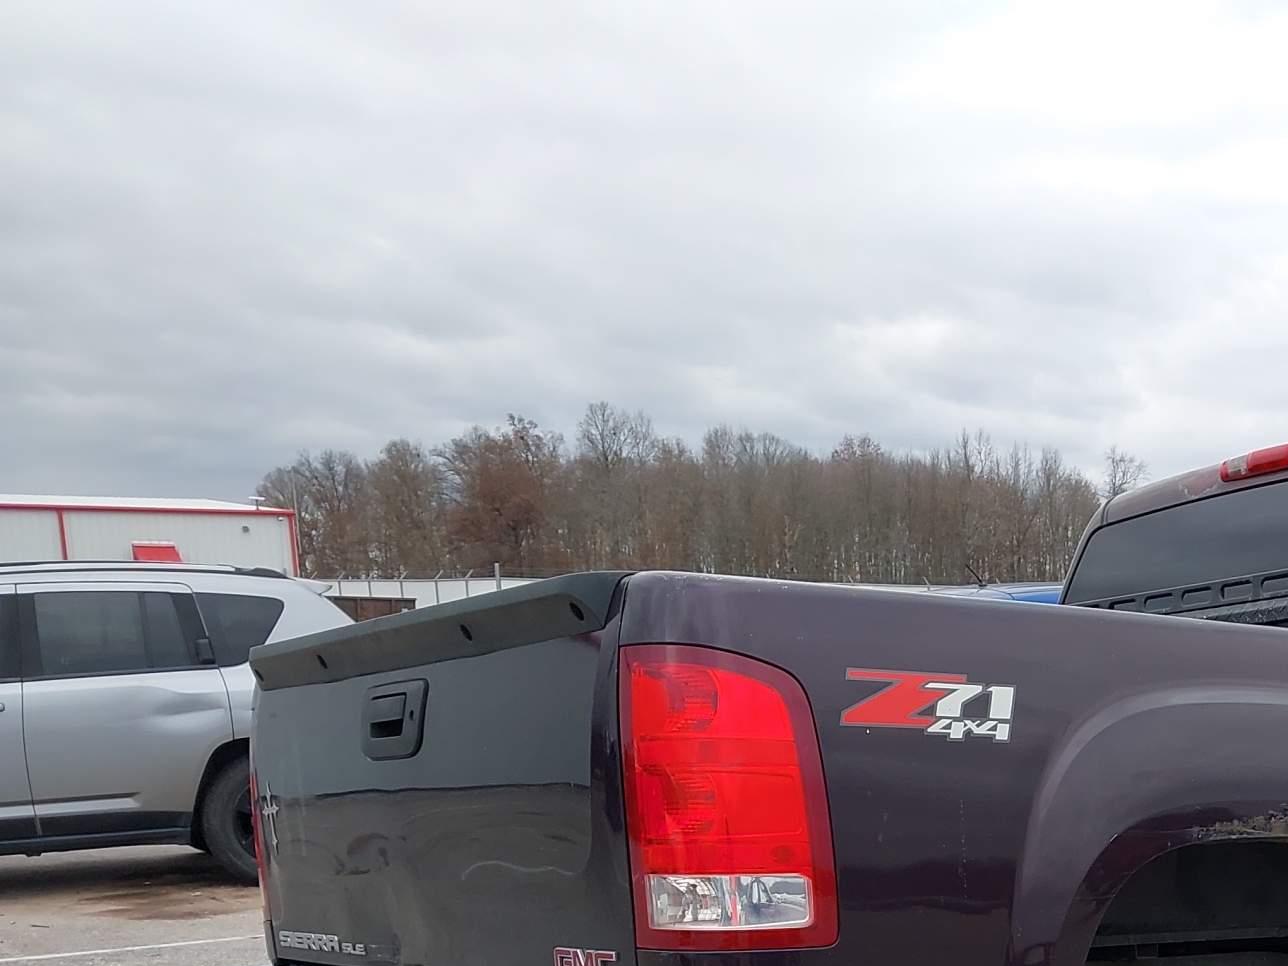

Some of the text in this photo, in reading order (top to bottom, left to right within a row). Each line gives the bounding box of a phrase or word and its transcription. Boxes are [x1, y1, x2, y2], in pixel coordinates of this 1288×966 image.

[840, 667, 1016, 727] Z71
[279, 930, 367, 956] SIERRA SLE
